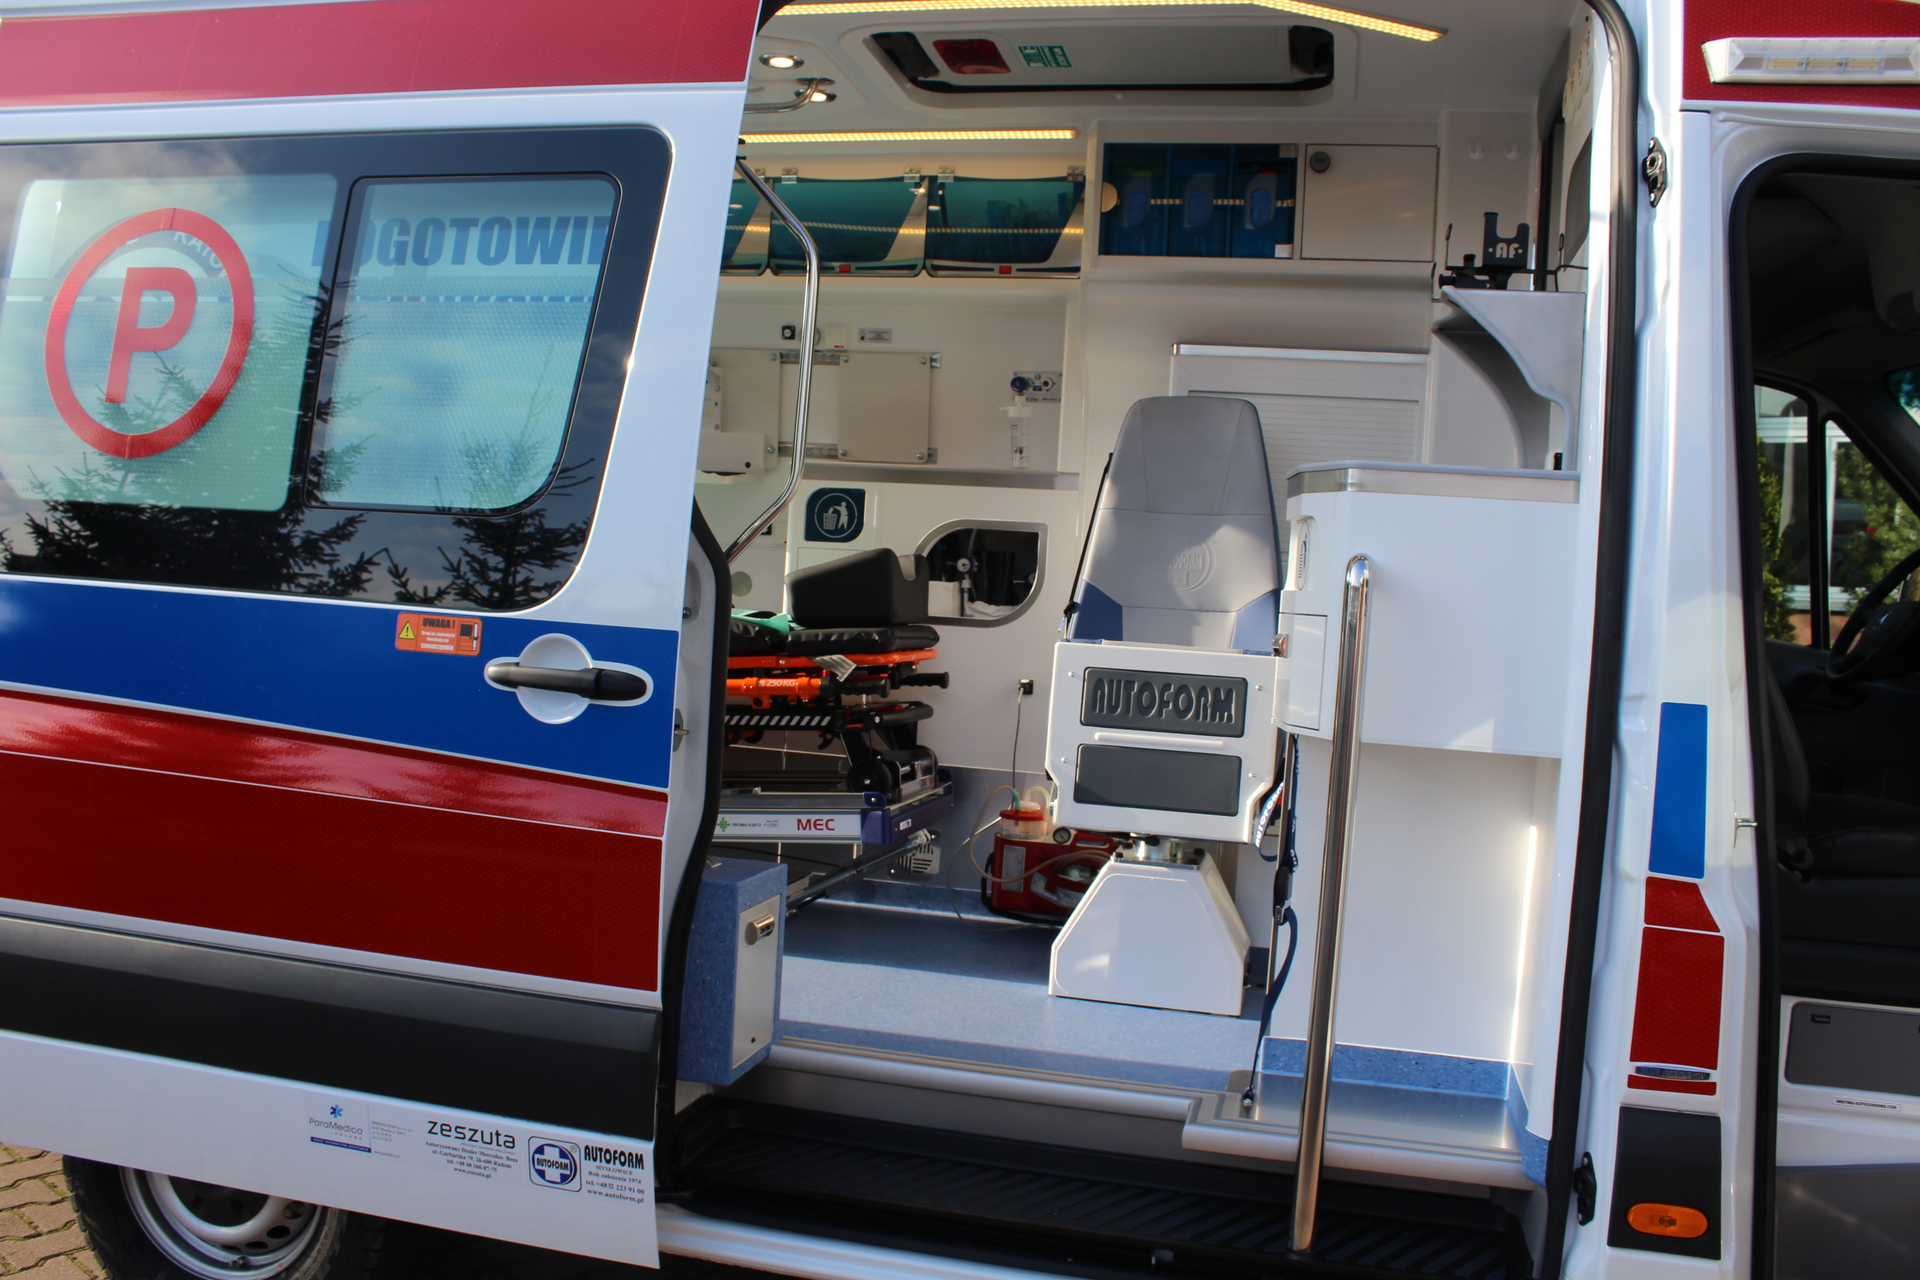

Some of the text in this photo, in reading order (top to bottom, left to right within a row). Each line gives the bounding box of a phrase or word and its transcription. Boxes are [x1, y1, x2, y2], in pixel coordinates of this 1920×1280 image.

[1495, 242, 1520, 258] AF
[104, 267, 196, 404] P
[423, 618, 451, 629] UWAGA
[421, 643, 454, 651] samoczynnie
[1093, 678, 1236, 724] AUTOFORM
[797, 818, 835, 831] MEC
[309, 1117, 363, 1135] ParaMedica
[427, 1120, 516, 1149] zeszuta
[426, 1141, 460, 1153] Autoryzowany
[461, 1147, 478, 1156] Dealer
[506, 1155, 519, 1163] Benz
[584, 1145, 644, 1170] AUTOFORM
[493, 1160, 512, 1169] Radom
[536, 1157, 569, 1171] AUTOFORM
[453, 1166, 492, 1179] www.zeszuta.pl
[601, 1173, 627, 1182] założenia
[616, 1184, 627, 1192] 223
[587, 1189, 644, 1204] www.autoform.pl
